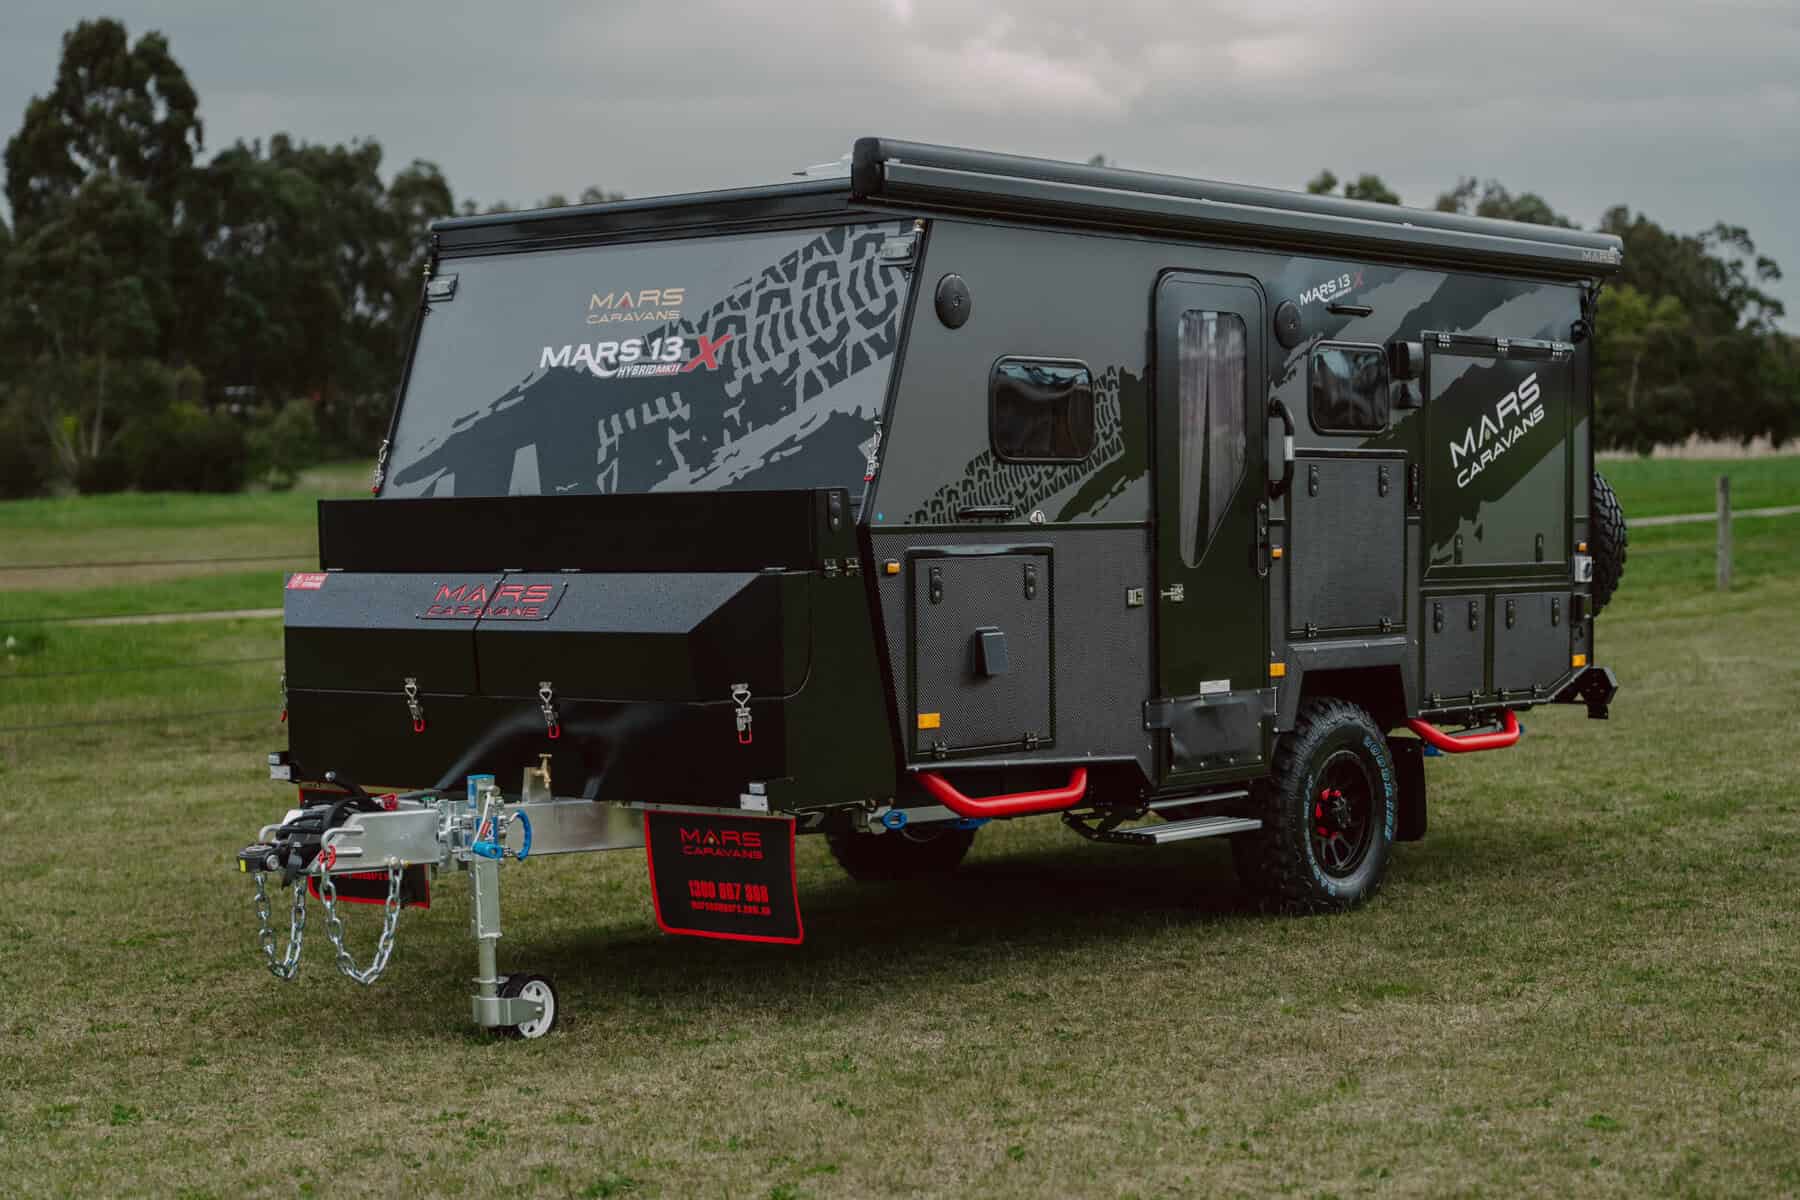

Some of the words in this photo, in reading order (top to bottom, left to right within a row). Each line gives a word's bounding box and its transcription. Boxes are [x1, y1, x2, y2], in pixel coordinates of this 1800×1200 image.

[590, 287, 685, 309] MARS
[1299, 280, 1337, 306] MARS
[1338, 273, 1351, 289] 13
[587, 310, 681, 325] CARAVANS
[540, 337, 642, 378] MARS
[651, 335, 684, 361] 13
[680, 335, 733, 373] X
[1449, 372, 1540, 468] MARS
[1457, 404, 1544, 488] CARAVANS
[434, 584, 553, 602] MARS
[427, 604, 540, 617] CARAVANS
[679, 828, 761, 847] MARS
[682, 846, 763, 859] CARAVANS
